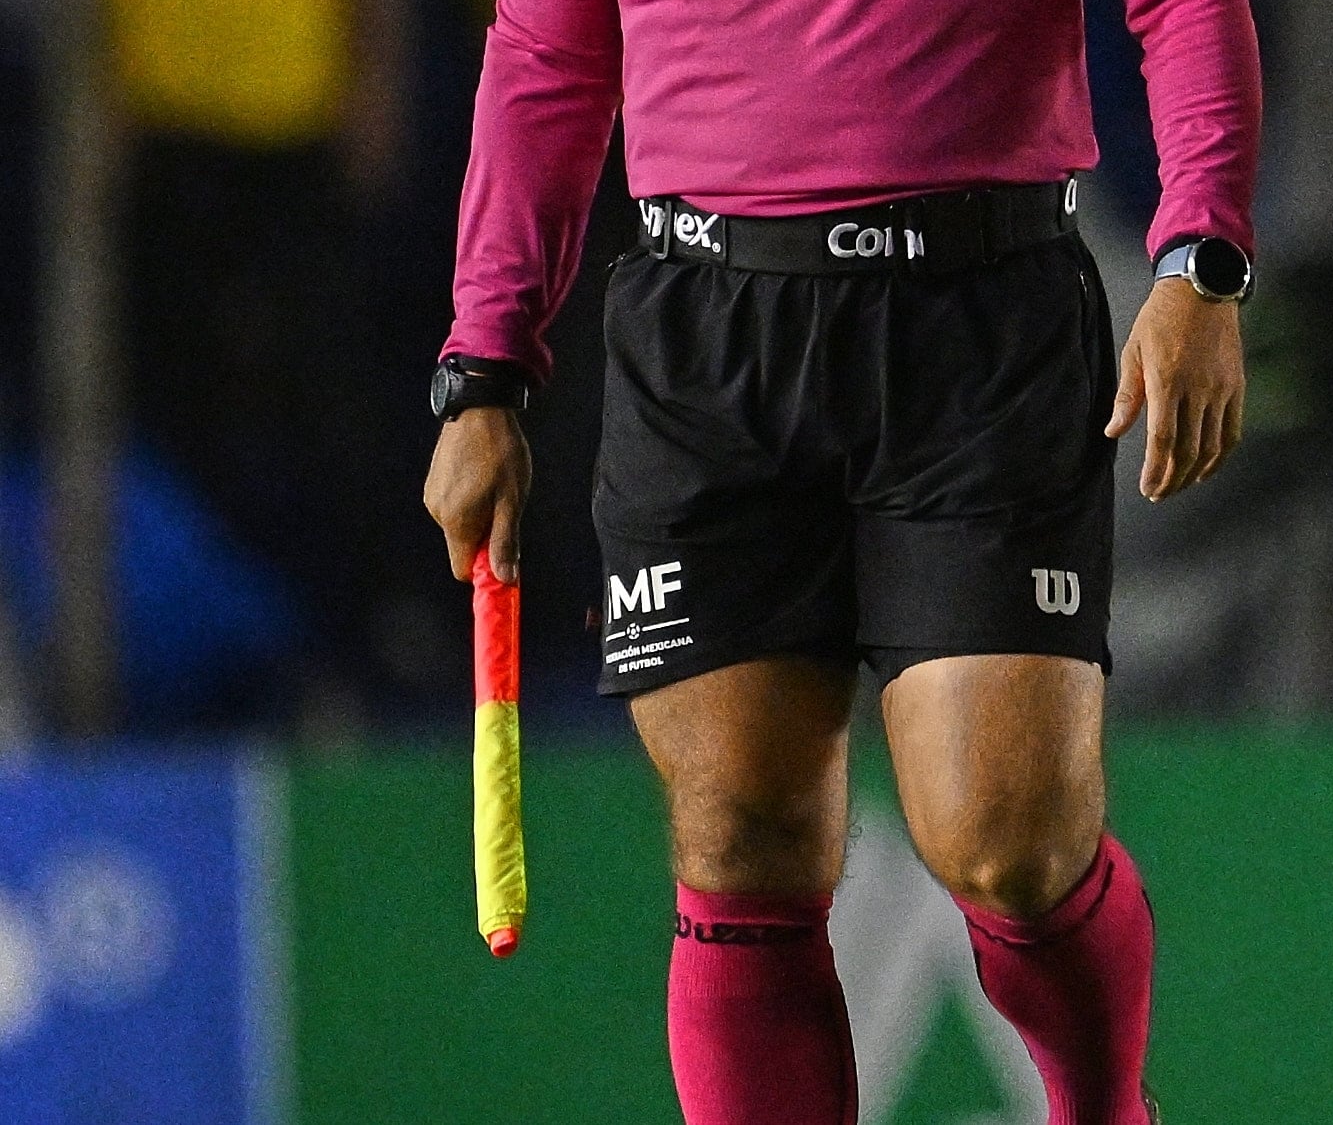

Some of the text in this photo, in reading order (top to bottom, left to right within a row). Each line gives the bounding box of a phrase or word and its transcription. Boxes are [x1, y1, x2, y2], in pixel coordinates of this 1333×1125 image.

[607, 561, 682, 625] MF
[641, 635, 694, 654] MEXICANA
[629, 656, 664, 671] FUTBOL
